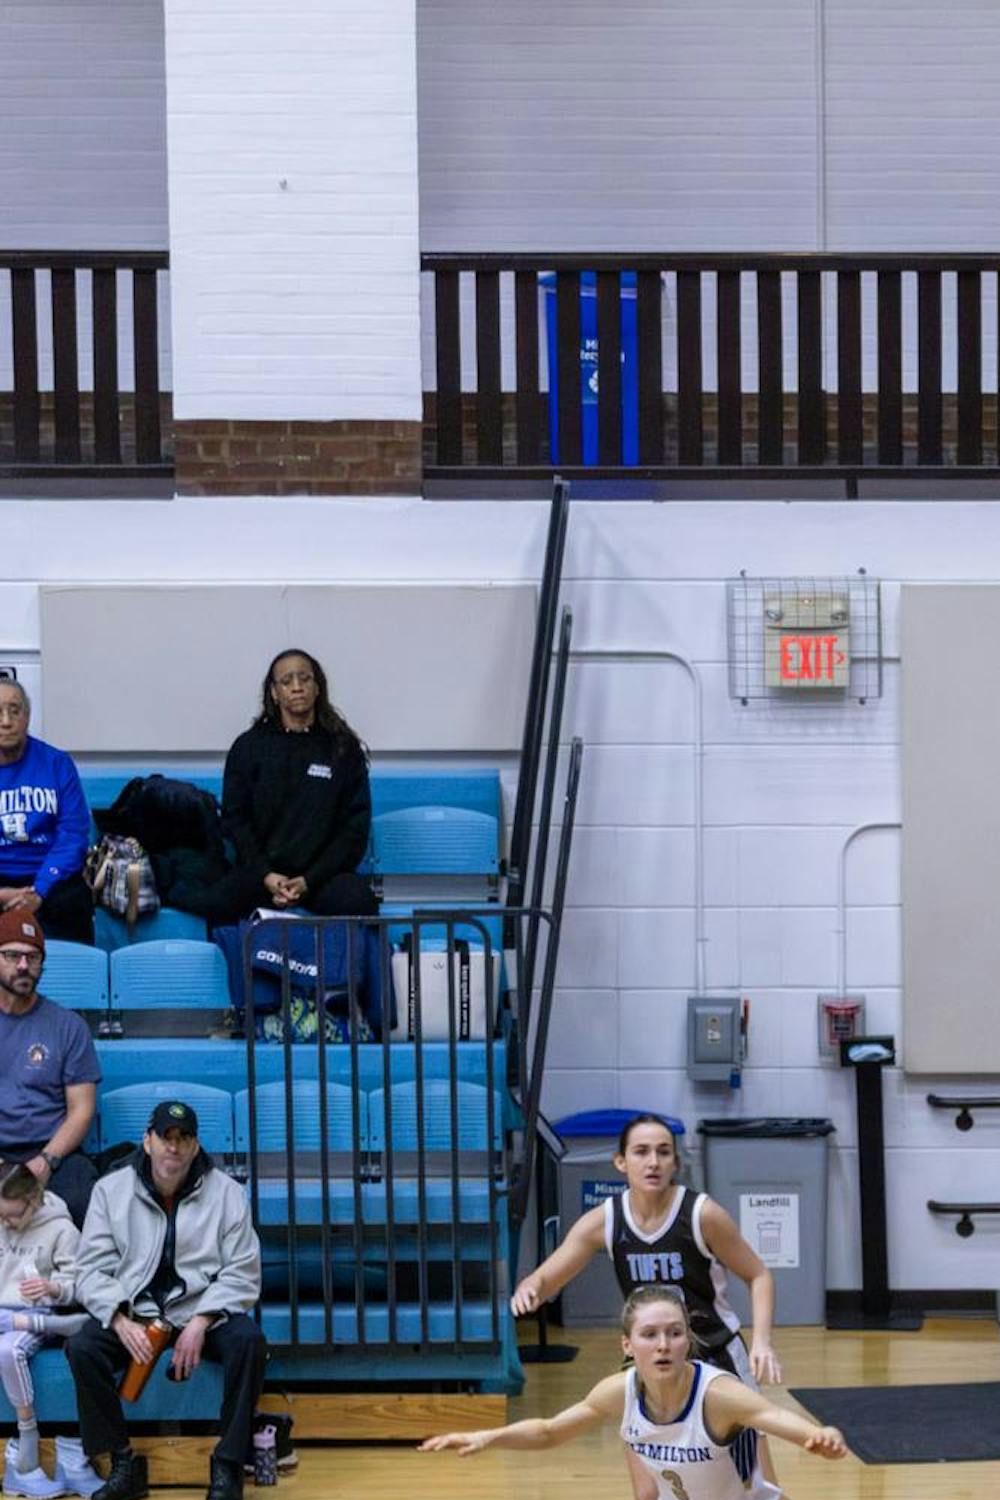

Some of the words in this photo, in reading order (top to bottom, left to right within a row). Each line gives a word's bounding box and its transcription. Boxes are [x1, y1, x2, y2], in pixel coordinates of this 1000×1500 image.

[779, 635, 838, 680] EXIT
[749, 1197, 791, 1208] Landfill
[626, 1252, 685, 1281] TUFTS
[628, 1443, 714, 1463] AMILTON
